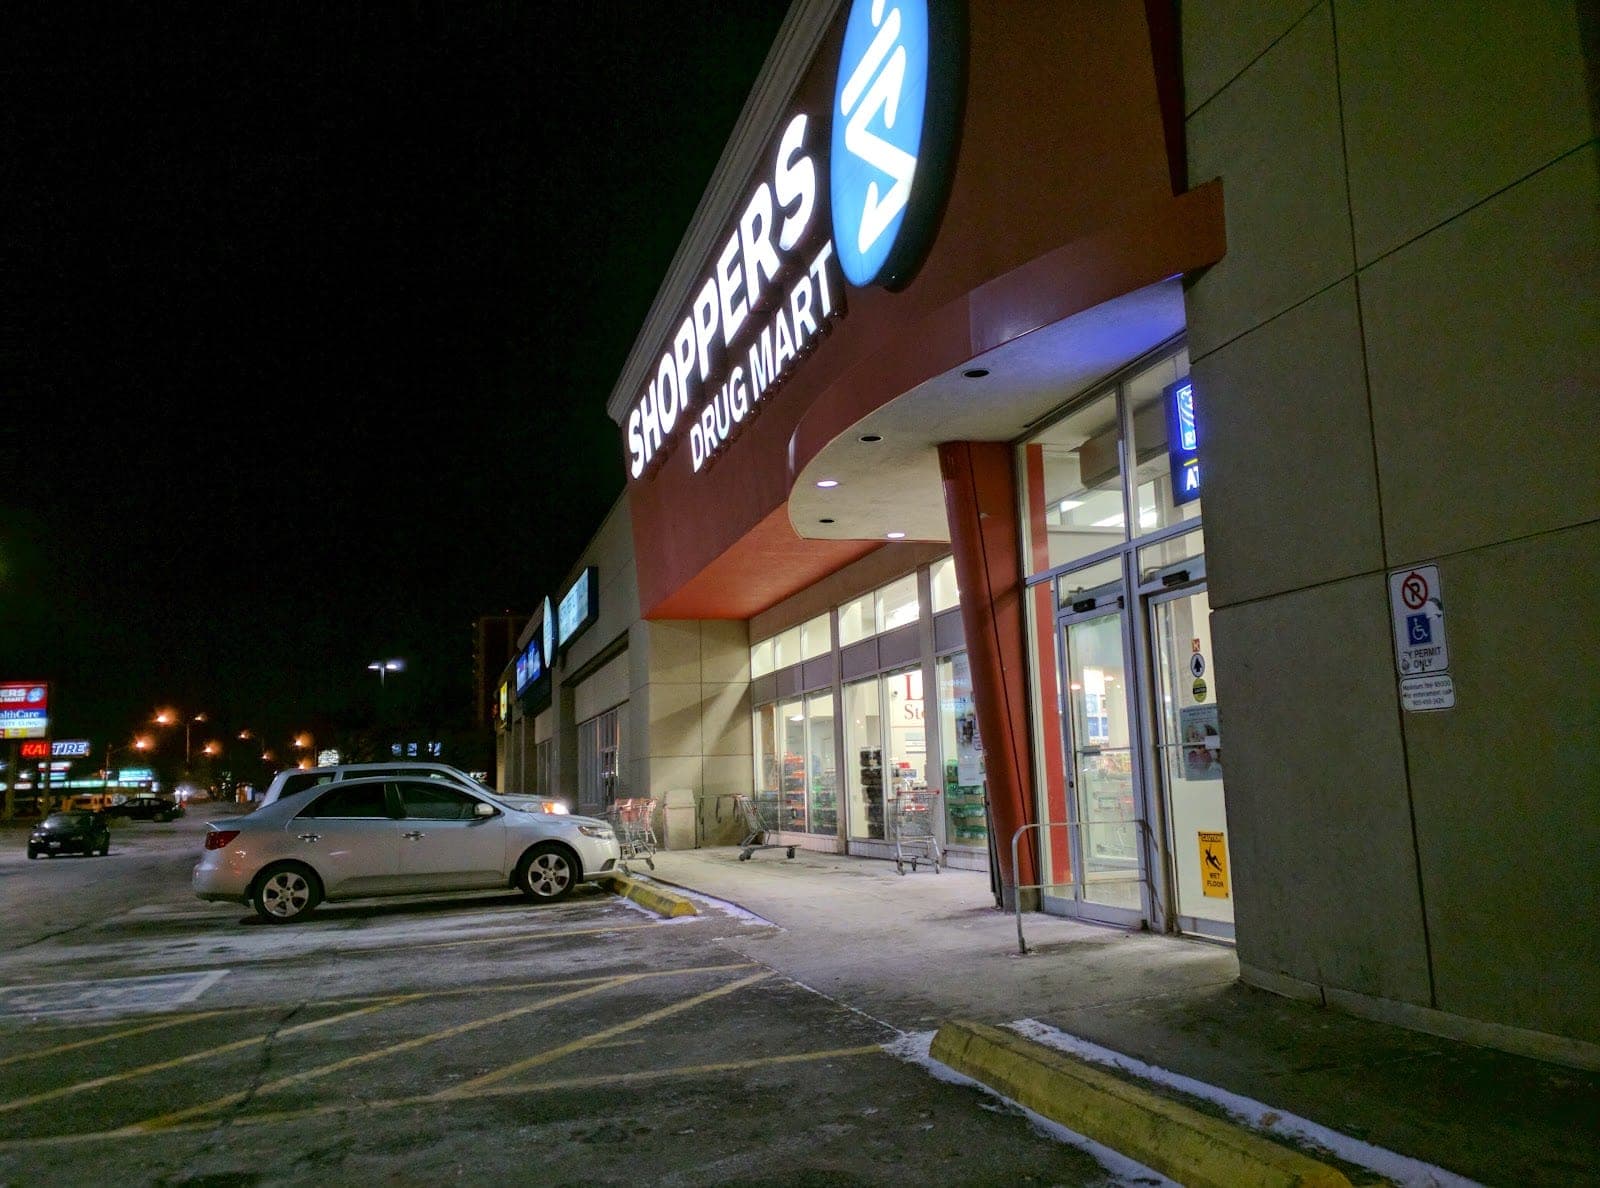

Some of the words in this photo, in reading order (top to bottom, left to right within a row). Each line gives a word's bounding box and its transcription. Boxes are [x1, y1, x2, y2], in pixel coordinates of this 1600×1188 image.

[628, 113, 816, 479] SHOPPERS
[690, 366, 748, 473] DRUG
[750, 240, 833, 402] MART
[1414, 647, 1442, 659] PERMIT
[1414, 659, 1432, 669] ONLY
[52, 743, 86, 754] TIRE
